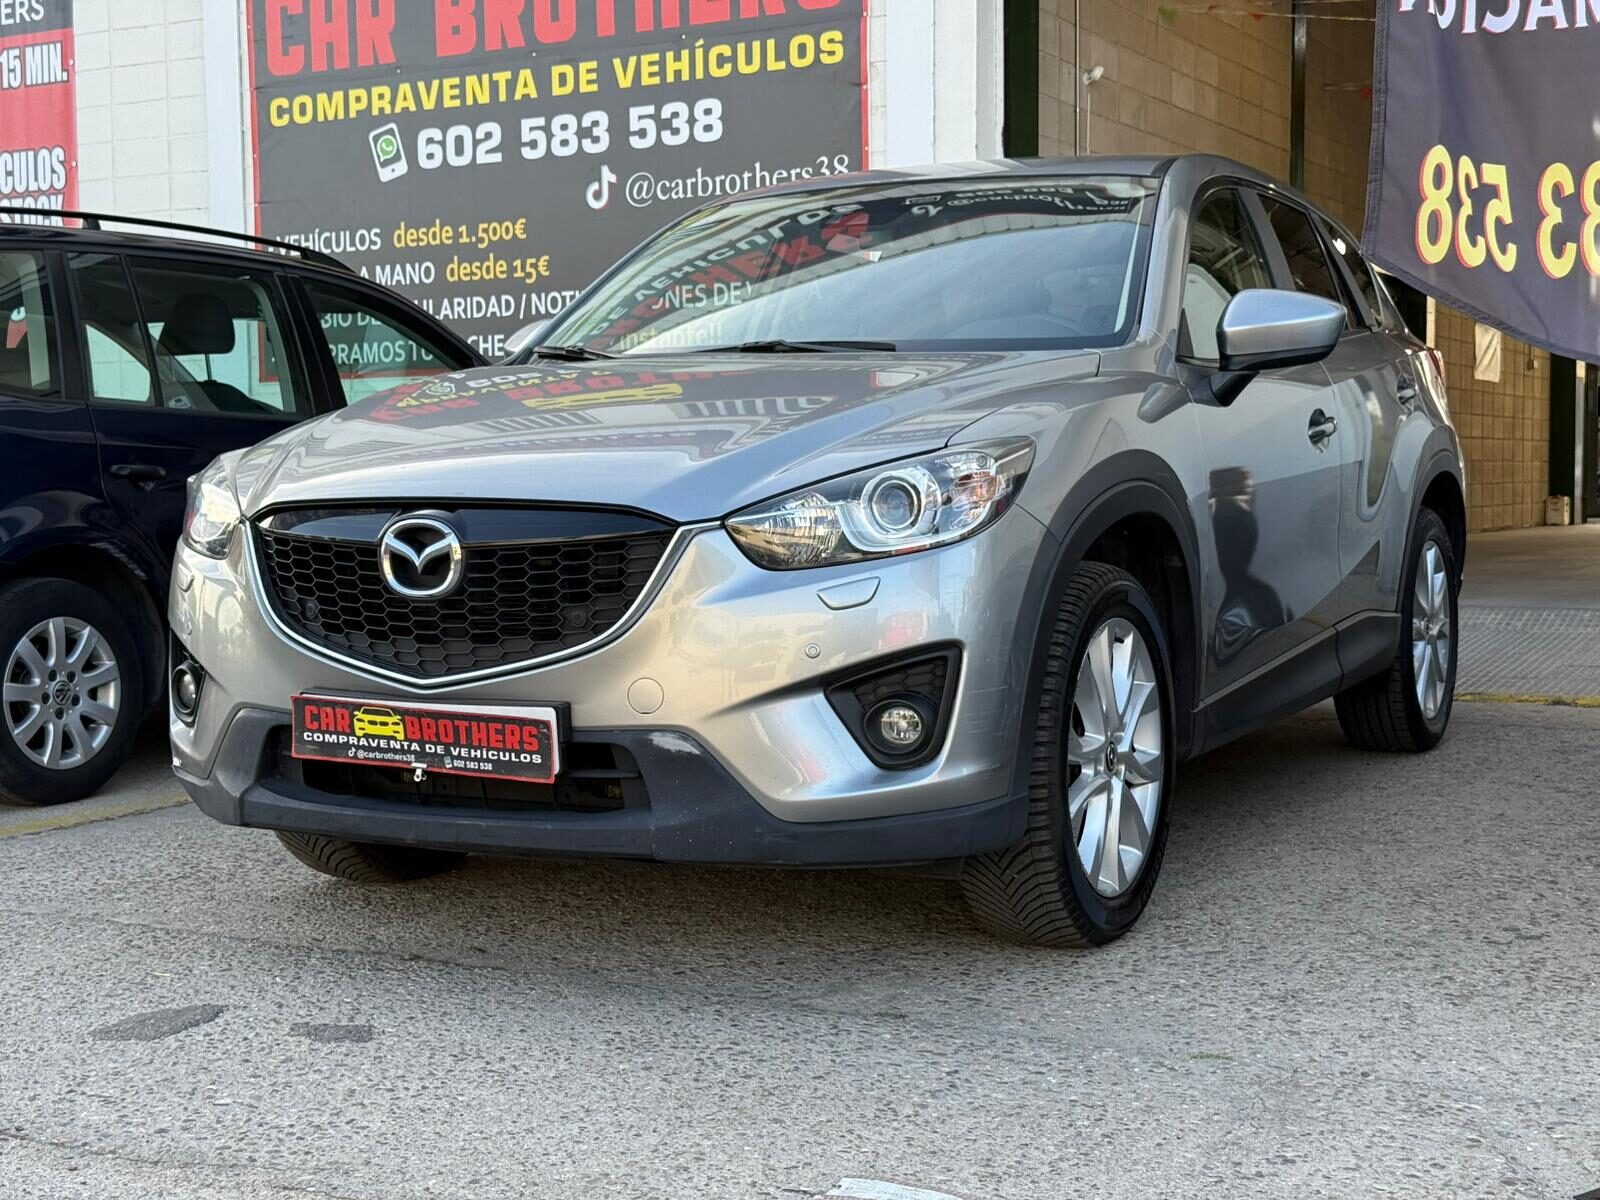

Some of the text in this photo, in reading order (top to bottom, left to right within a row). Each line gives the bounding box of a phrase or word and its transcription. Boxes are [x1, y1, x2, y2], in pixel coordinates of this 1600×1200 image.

[0, 42, 68, 89] 15 MIN.
[270, 30, 844, 127] COMPRAVENTA DE VEHÍCULOS
[417, 98, 723, 170] 602 583 538
[625, 154, 850, 207] @carbrothers38
[393, 219, 452, 248] desde
[458, 218, 527, 248] 1.500€
[375, 261, 435, 287] MANO
[446, 253, 507, 282] desde
[513, 255, 550, 284] 15€
[303, 731, 542, 764] COMPRAVENTA DE VEHÍCULOS
[304, 705, 540, 751] CAR BROTHERS
